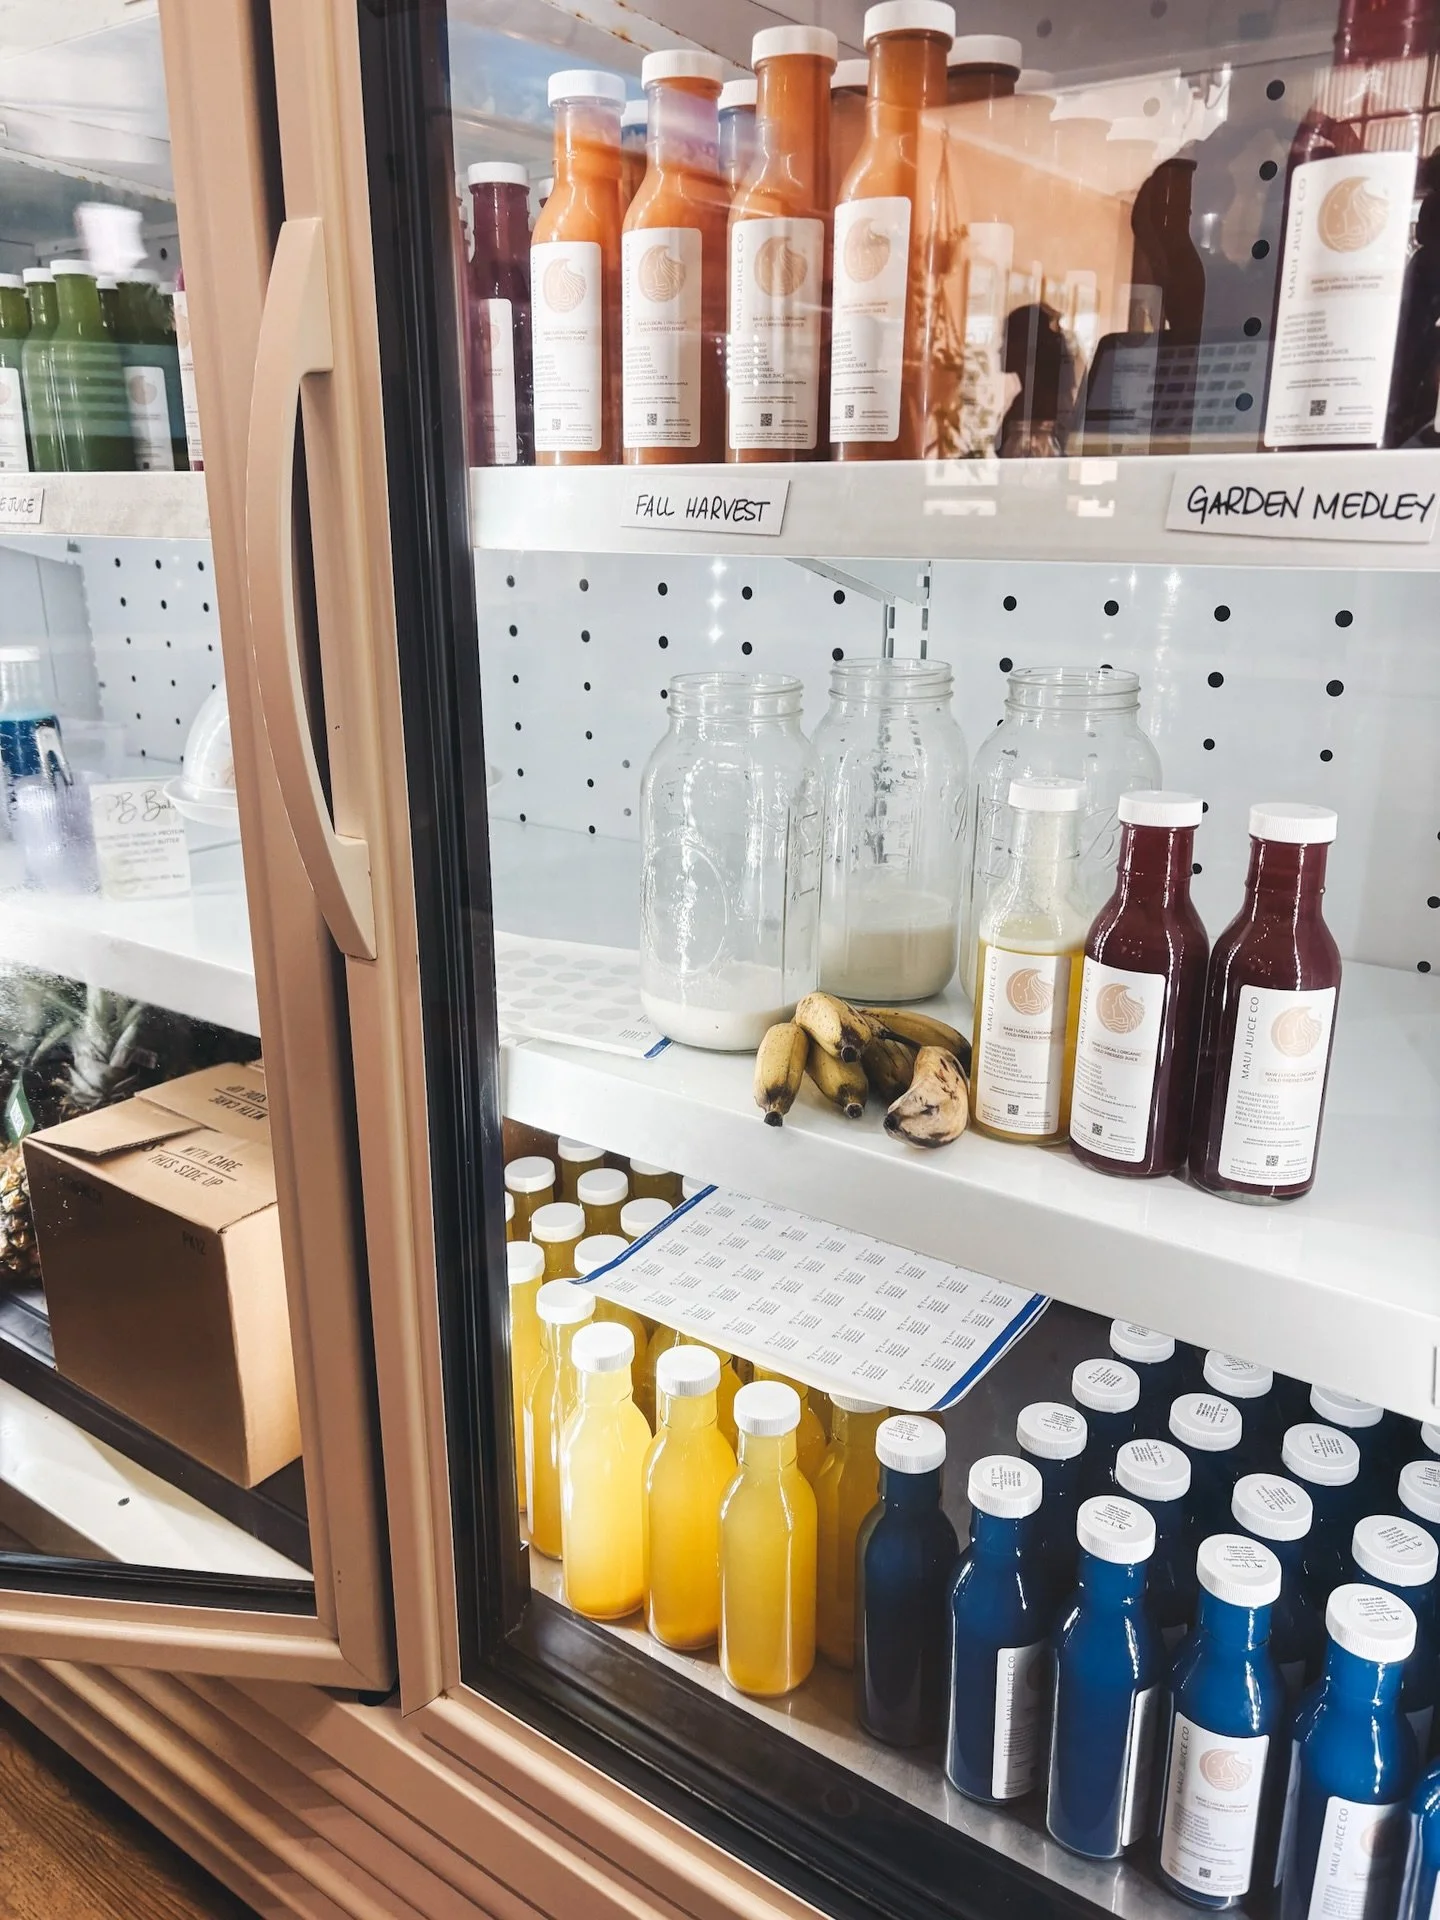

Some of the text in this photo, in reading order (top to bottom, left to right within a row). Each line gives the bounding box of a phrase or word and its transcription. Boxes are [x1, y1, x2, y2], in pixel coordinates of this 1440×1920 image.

[1288, 178, 1306, 299] MAUI JUICE CO
[8, 496, 34, 513] JUICE
[635, 494, 771, 522] FALL HARVEST
[1187, 485, 1436, 524] GARDEN MEDLEY
[157, 837, 180, 845] BUTTER
[986, 1006, 994, 1032] MAUI
[991, 956, 998, 972] CO
[1241, 996, 1260, 1080] MAUI JUICE CO
[148, 1154, 223, 1187] THIS SIDE UP
[180, 1146, 243, 1173] WITH CARE
[1008, 1656, 1015, 1668] CO
[1176, 1726, 1190, 1795] MAUI JUICE CO
[1329, 1808, 1349, 1877] MAUI JUICE CO
